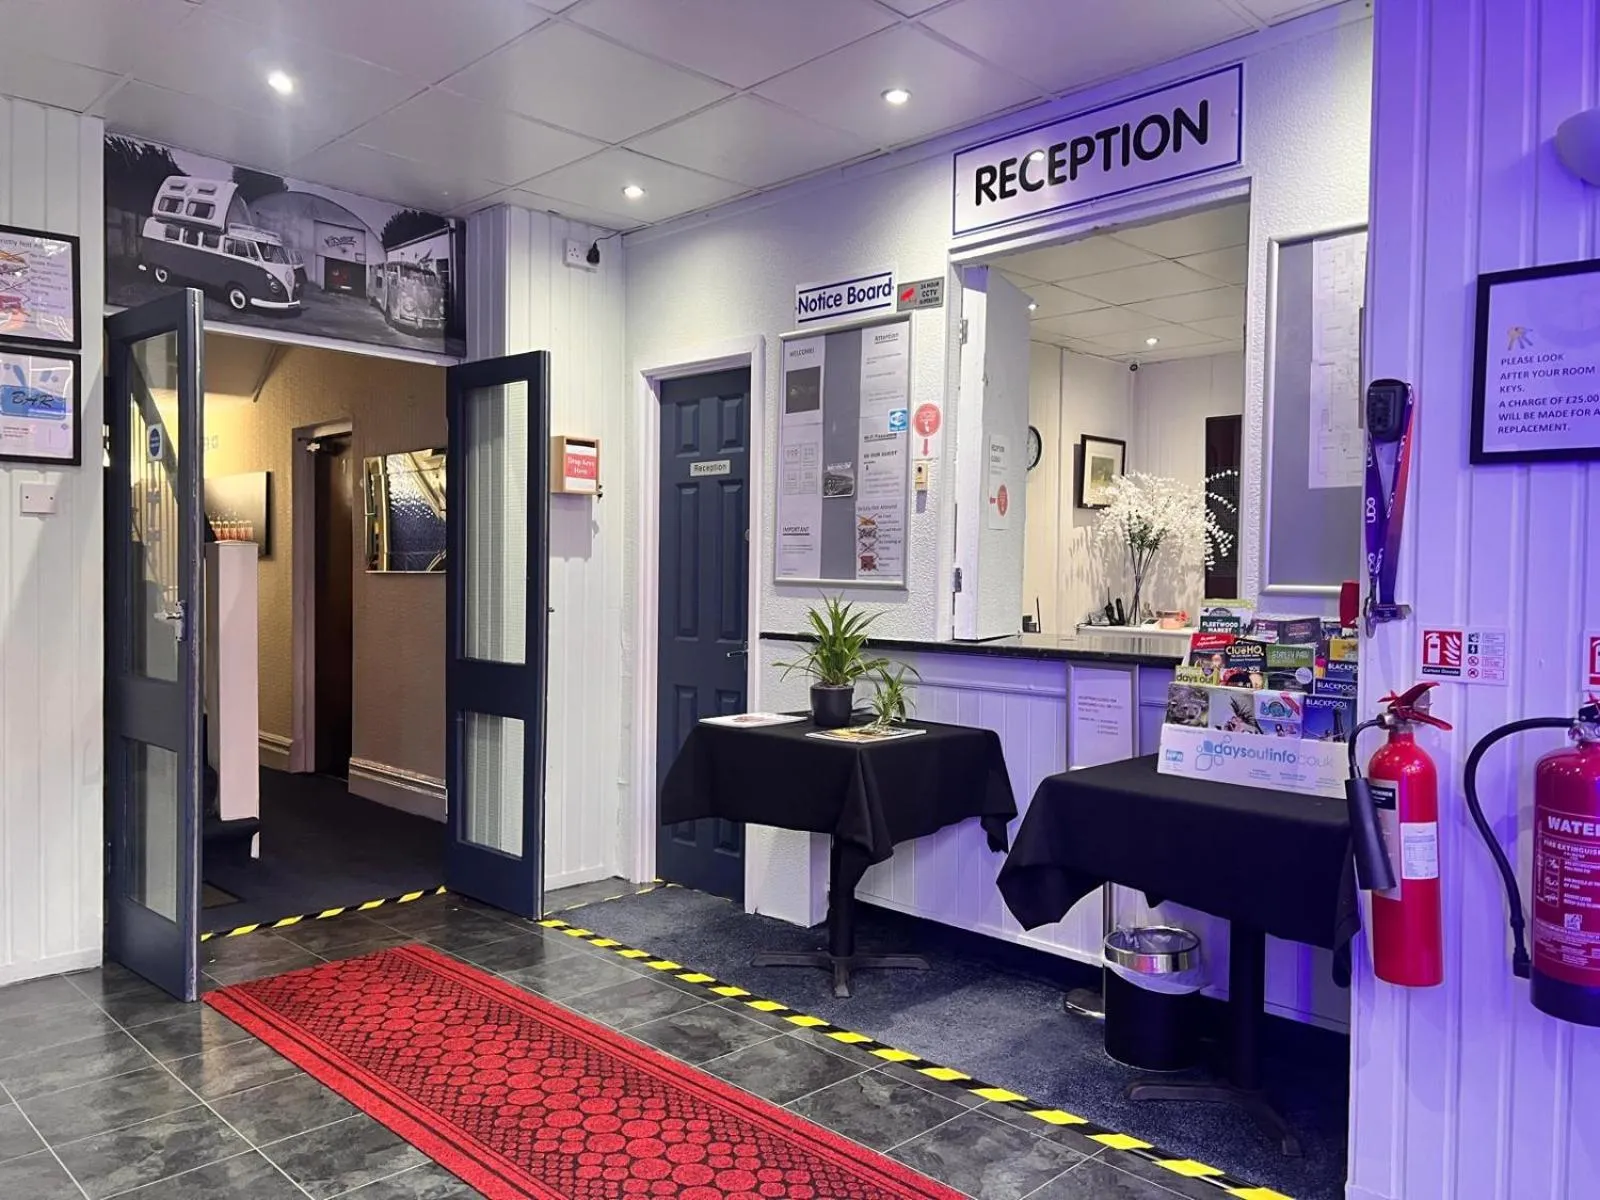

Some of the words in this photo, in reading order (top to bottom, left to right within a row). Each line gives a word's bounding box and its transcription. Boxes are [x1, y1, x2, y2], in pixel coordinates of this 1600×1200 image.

[975, 99, 1209, 206] RECEPTION
[798, 291, 842, 314] Notice
[847, 277, 892, 304] Board
[922, 289, 938, 298] CCTV
[1501, 355, 1534, 366] PLEASE
[1537, 353, 1564, 363] LOOK
[1500, 370, 1530, 380] AFTER
[1532, 368, 1560, 379] YOUR
[1562, 366, 1596, 376] ROOM
[1500, 384, 1525, 393] KEYS.
[1499, 400, 1506, 408] A
[1508, 397, 1548, 407] CHARGE
[1550, 396, 1565, 405] OF
[1498, 411, 1521, 421] WILL
[1523, 411, 1536, 420] BE
[1538, 409, 1569, 419] MADE
[1570, 408, 1591, 417] FOR
[1498, 423, 1570, 434] REPLACEMENT.
[1305, 698, 1347, 708] BLACKPOOL
